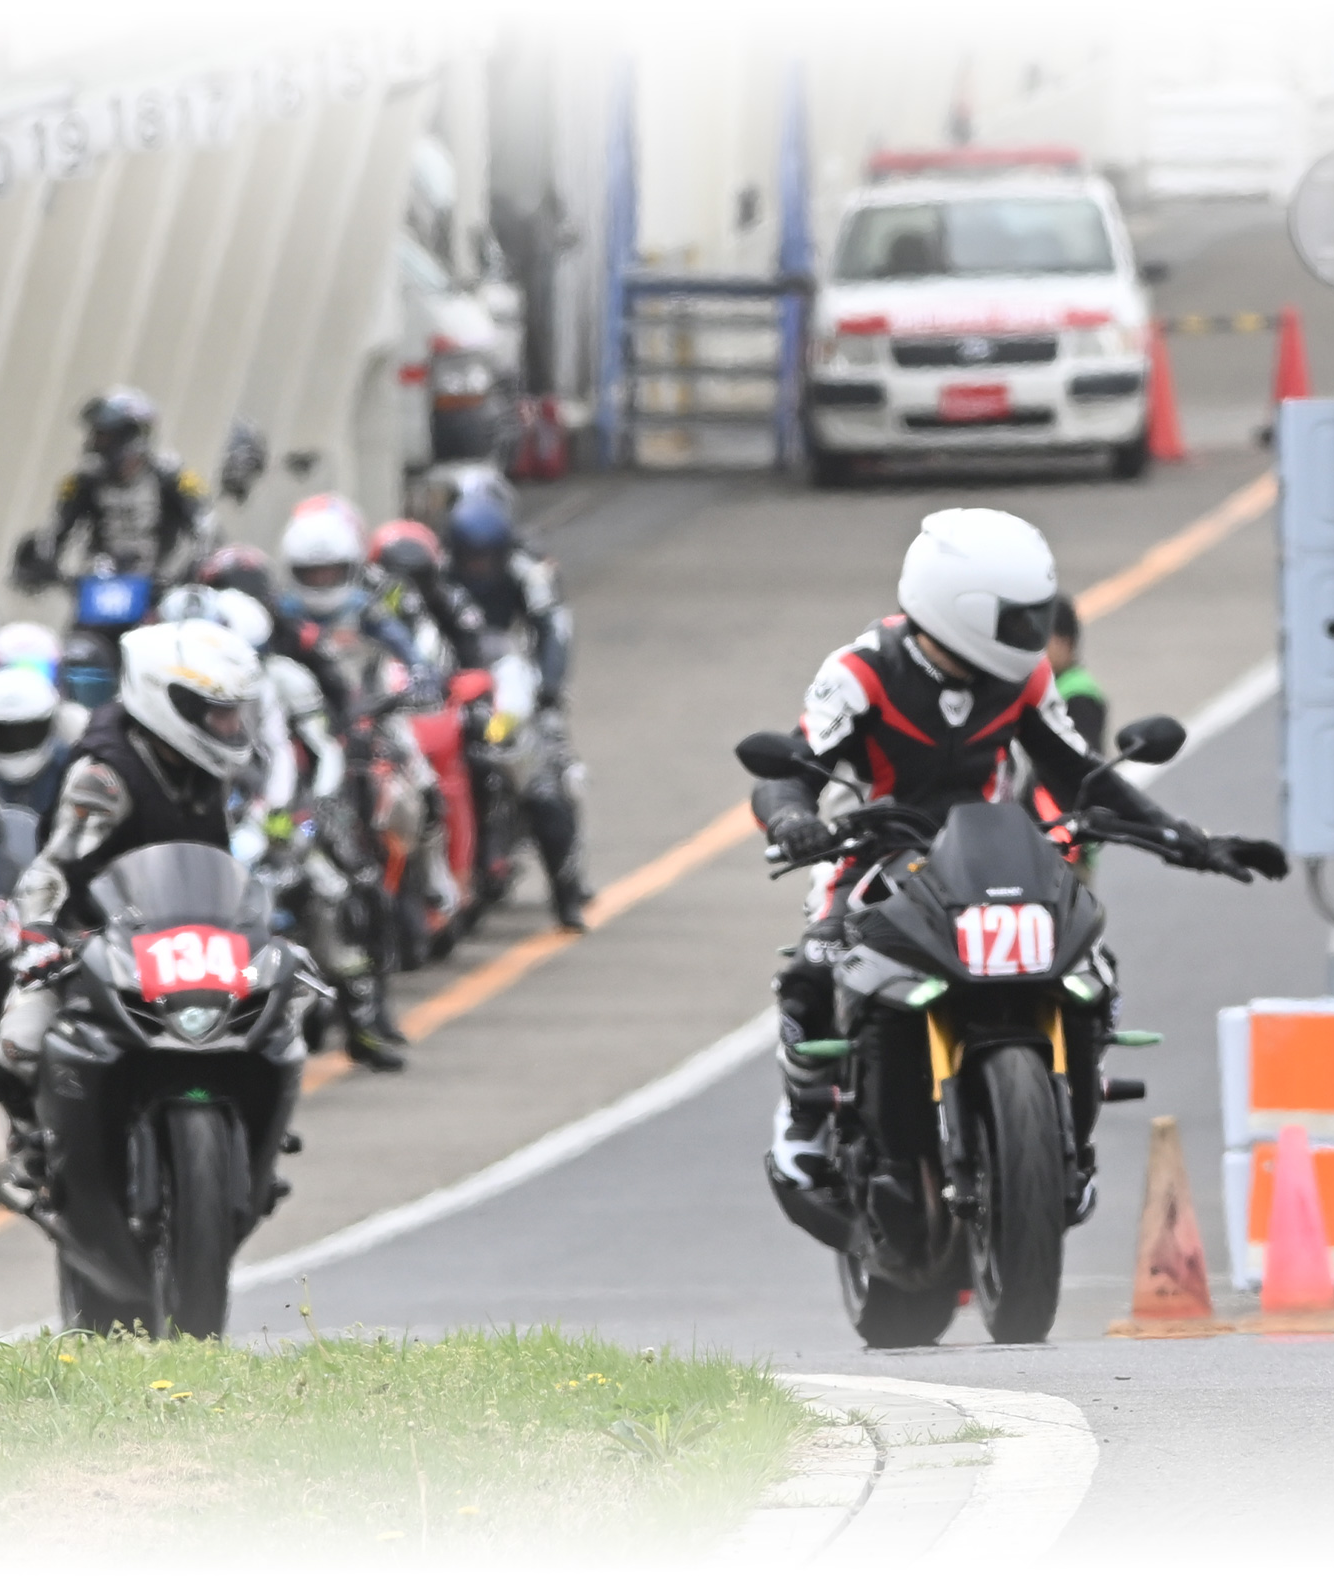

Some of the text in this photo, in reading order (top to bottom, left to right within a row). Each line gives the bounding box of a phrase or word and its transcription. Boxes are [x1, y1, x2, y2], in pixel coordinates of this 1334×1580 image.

[32, 114, 90, 177] 19
[110, 88, 166, 151] 18
[146, 931, 238, 986] 134
[957, 904, 1056, 976] 120
